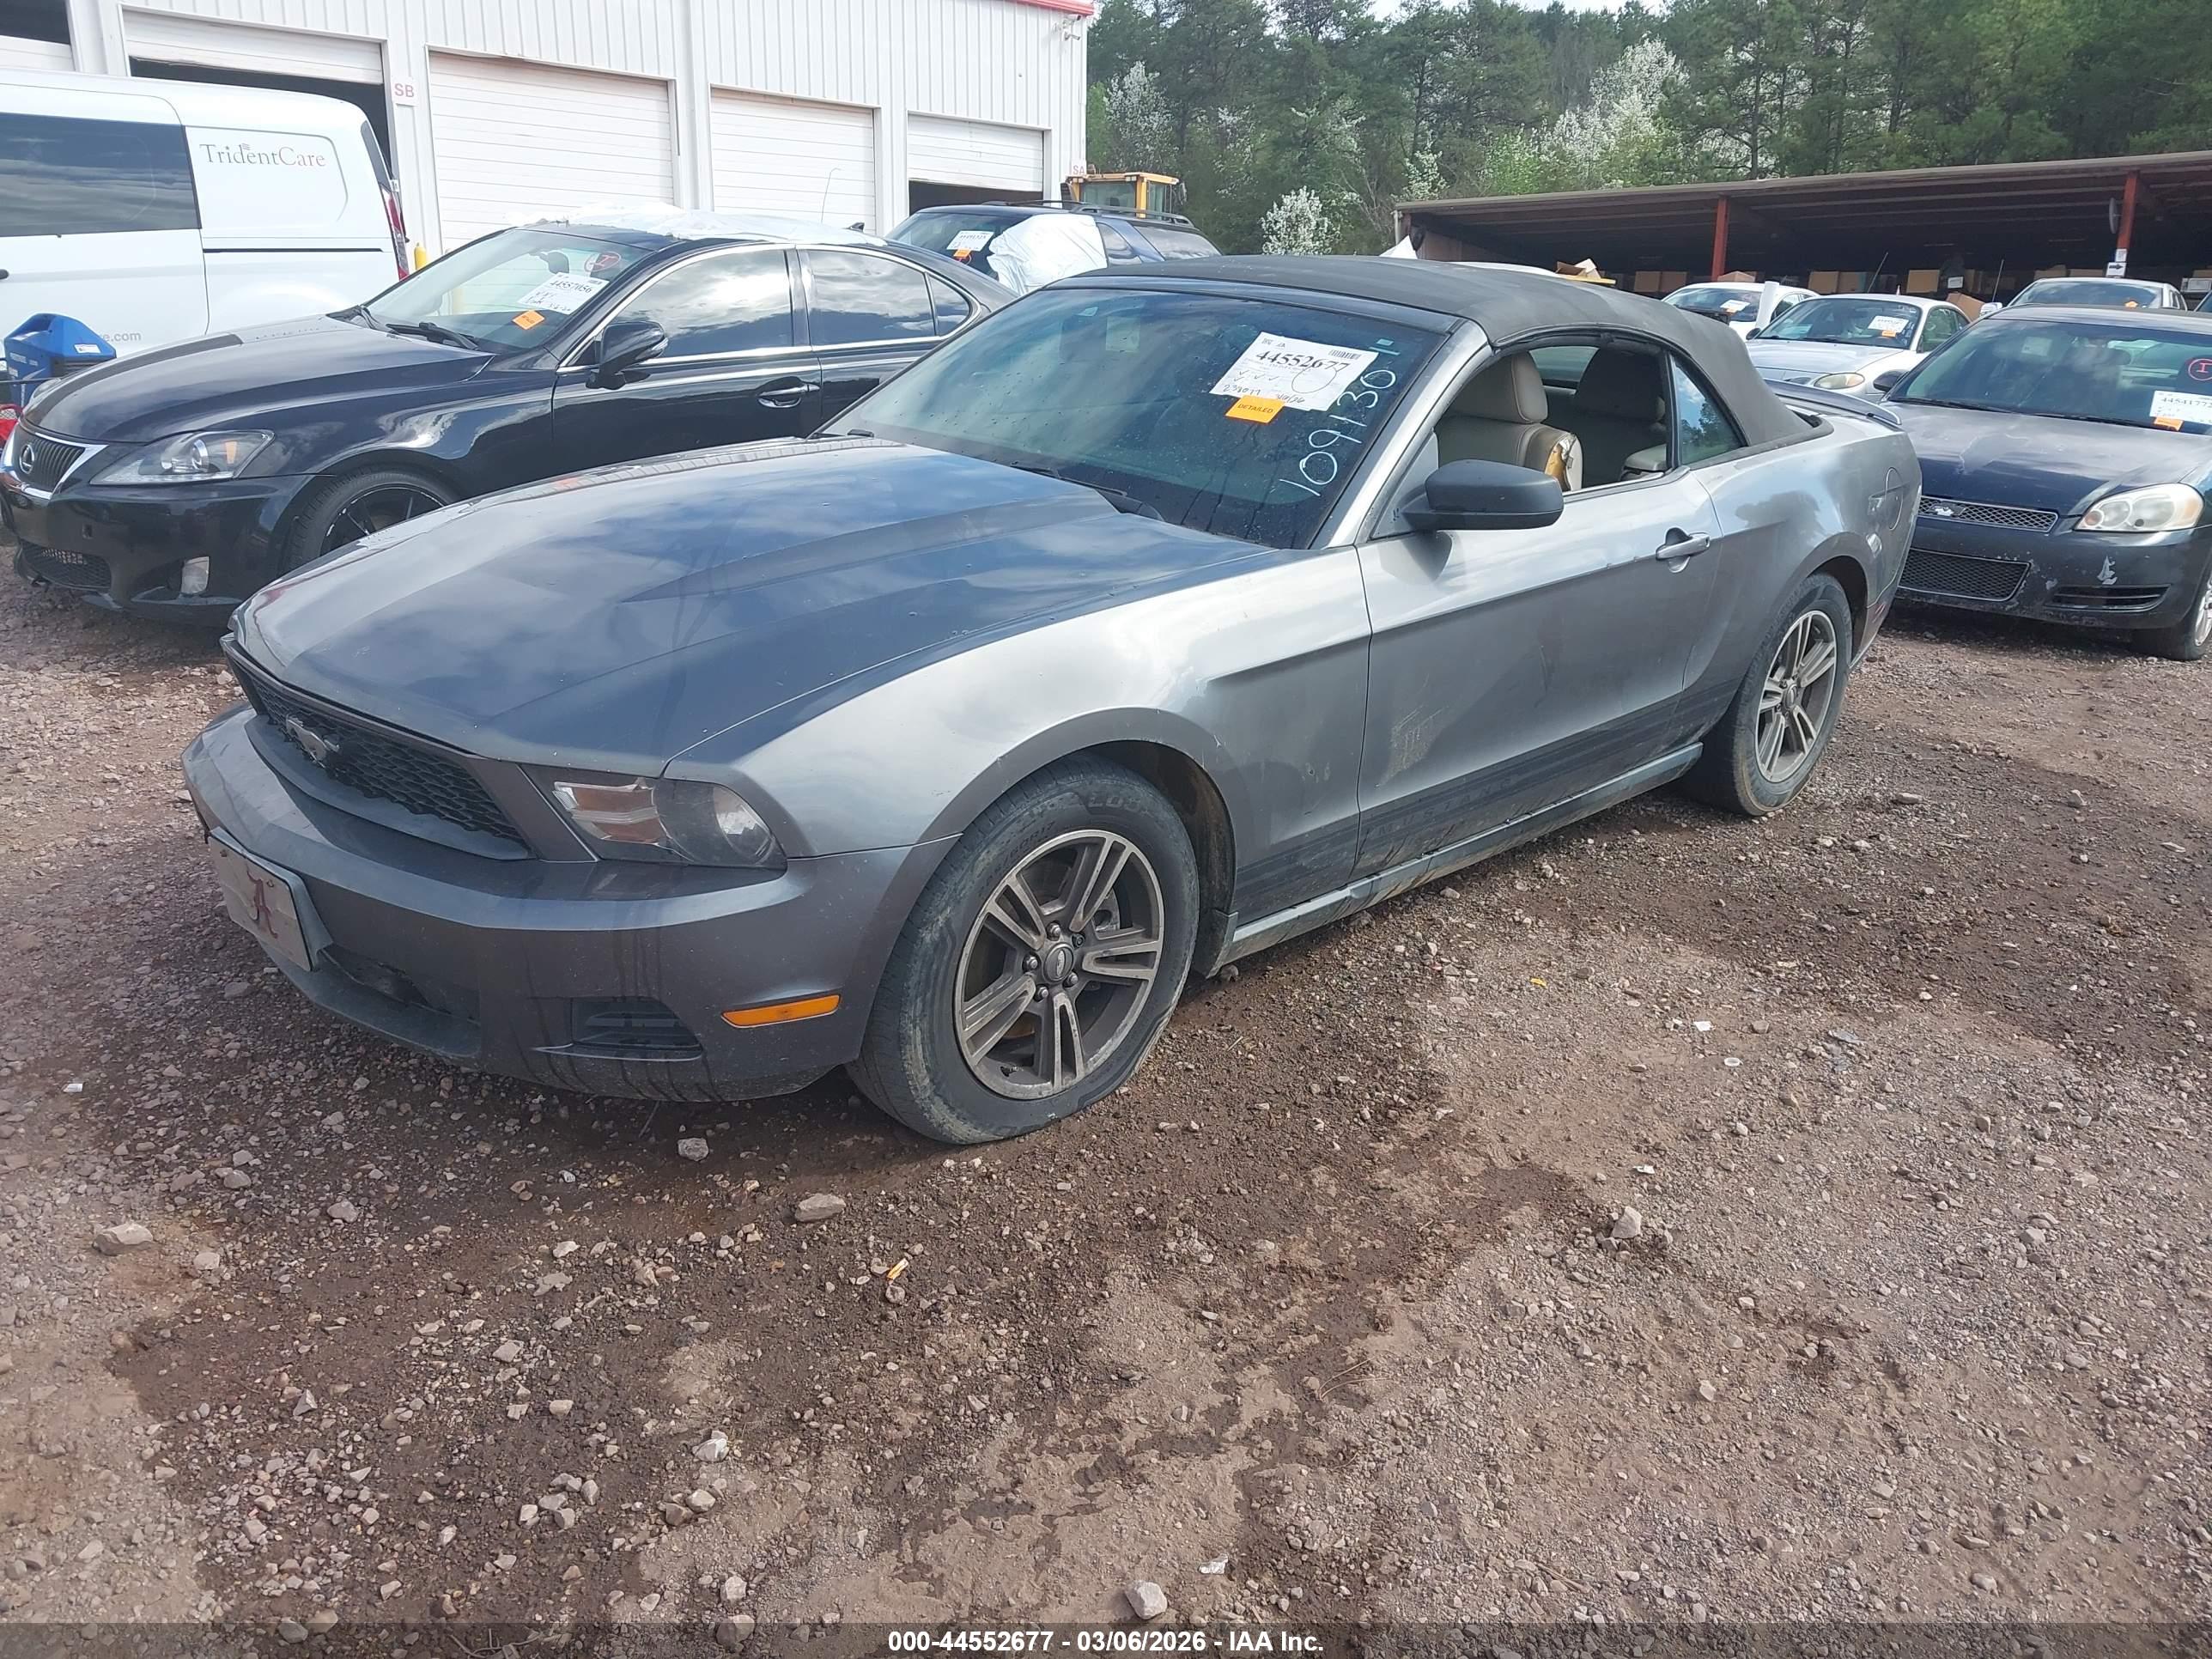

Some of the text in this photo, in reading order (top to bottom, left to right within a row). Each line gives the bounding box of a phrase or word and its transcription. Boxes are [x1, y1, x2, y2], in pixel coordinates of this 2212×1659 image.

[394, 83, 415, 98] SB
[199, 143, 326, 167] TridentCare
[1073, 165, 1085, 175] SA
[1255, 350, 1351, 371] 44552677
[1237, 404, 1274, 414] DETAILED
